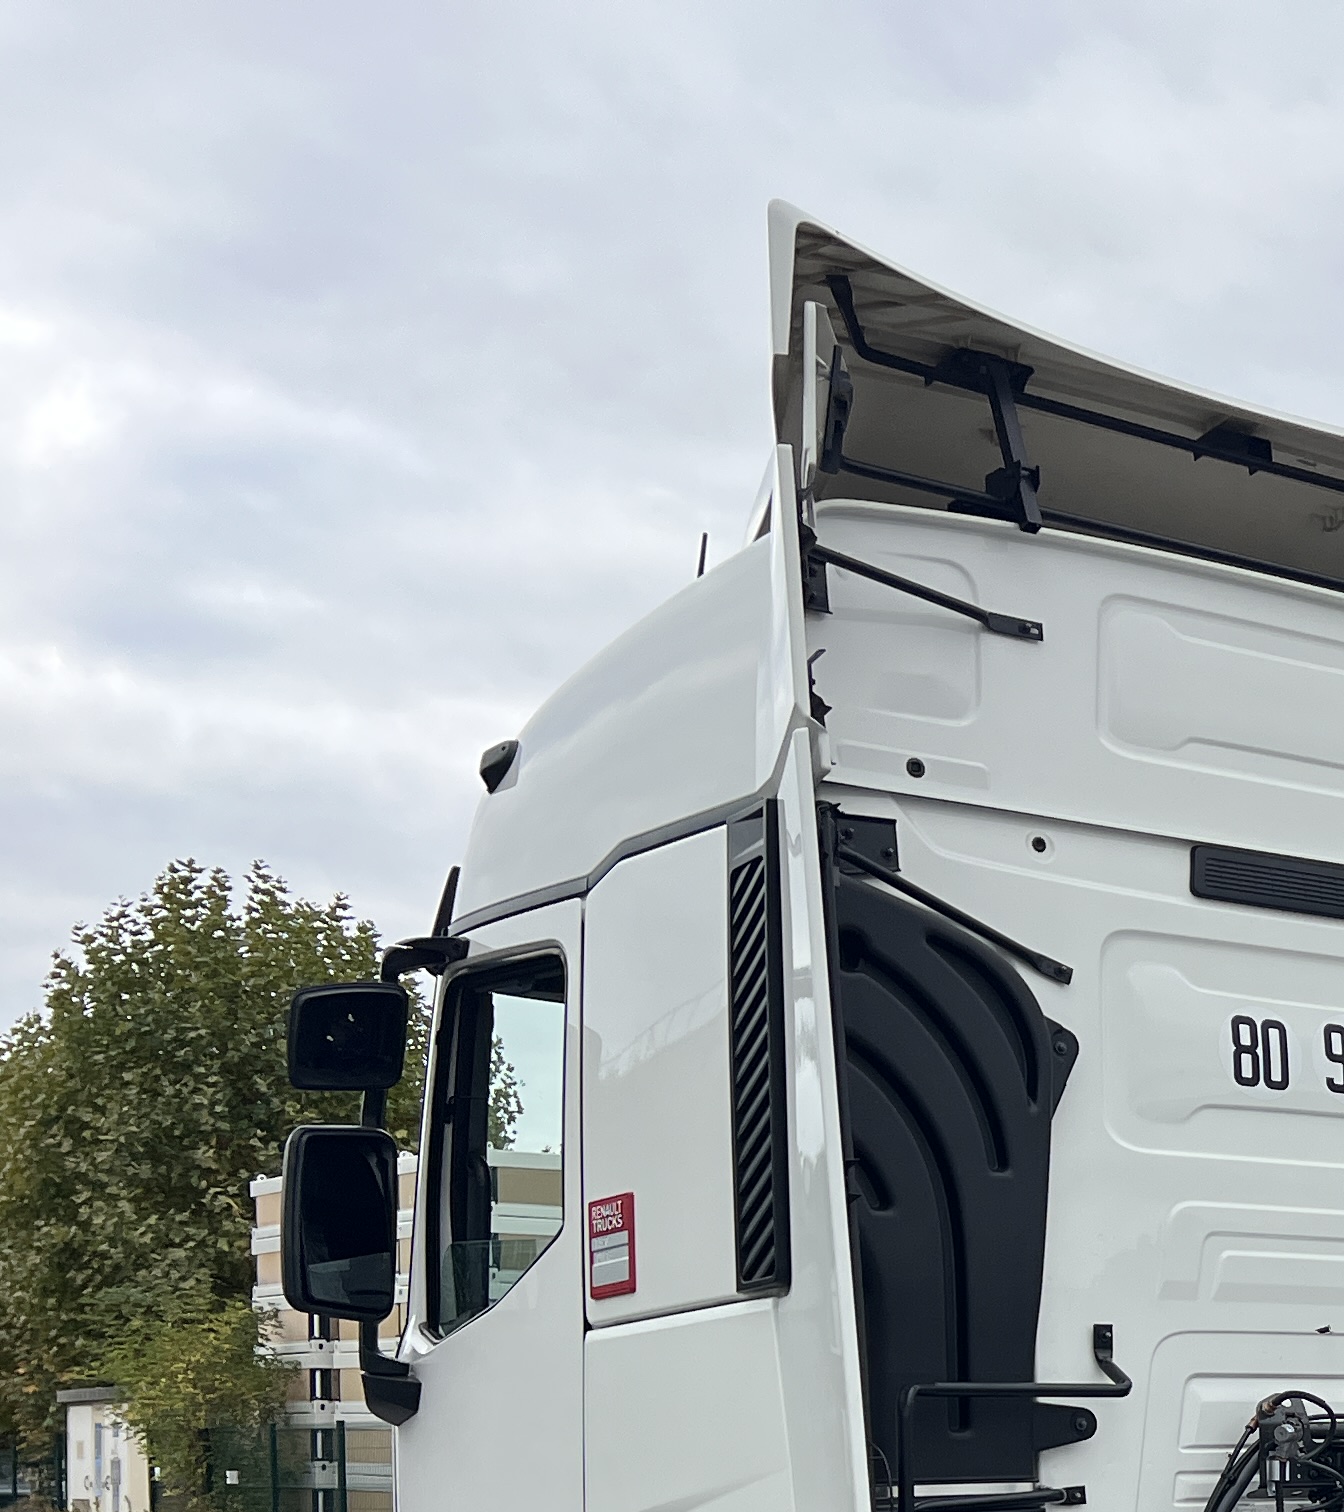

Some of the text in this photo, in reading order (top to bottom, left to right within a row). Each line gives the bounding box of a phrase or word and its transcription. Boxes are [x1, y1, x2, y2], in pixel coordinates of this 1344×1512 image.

[1230, 1014, 1290, 1091] 80
[591, 1200, 622, 1220] RENAULT
[592, 1214, 623, 1233] TRUCKS
